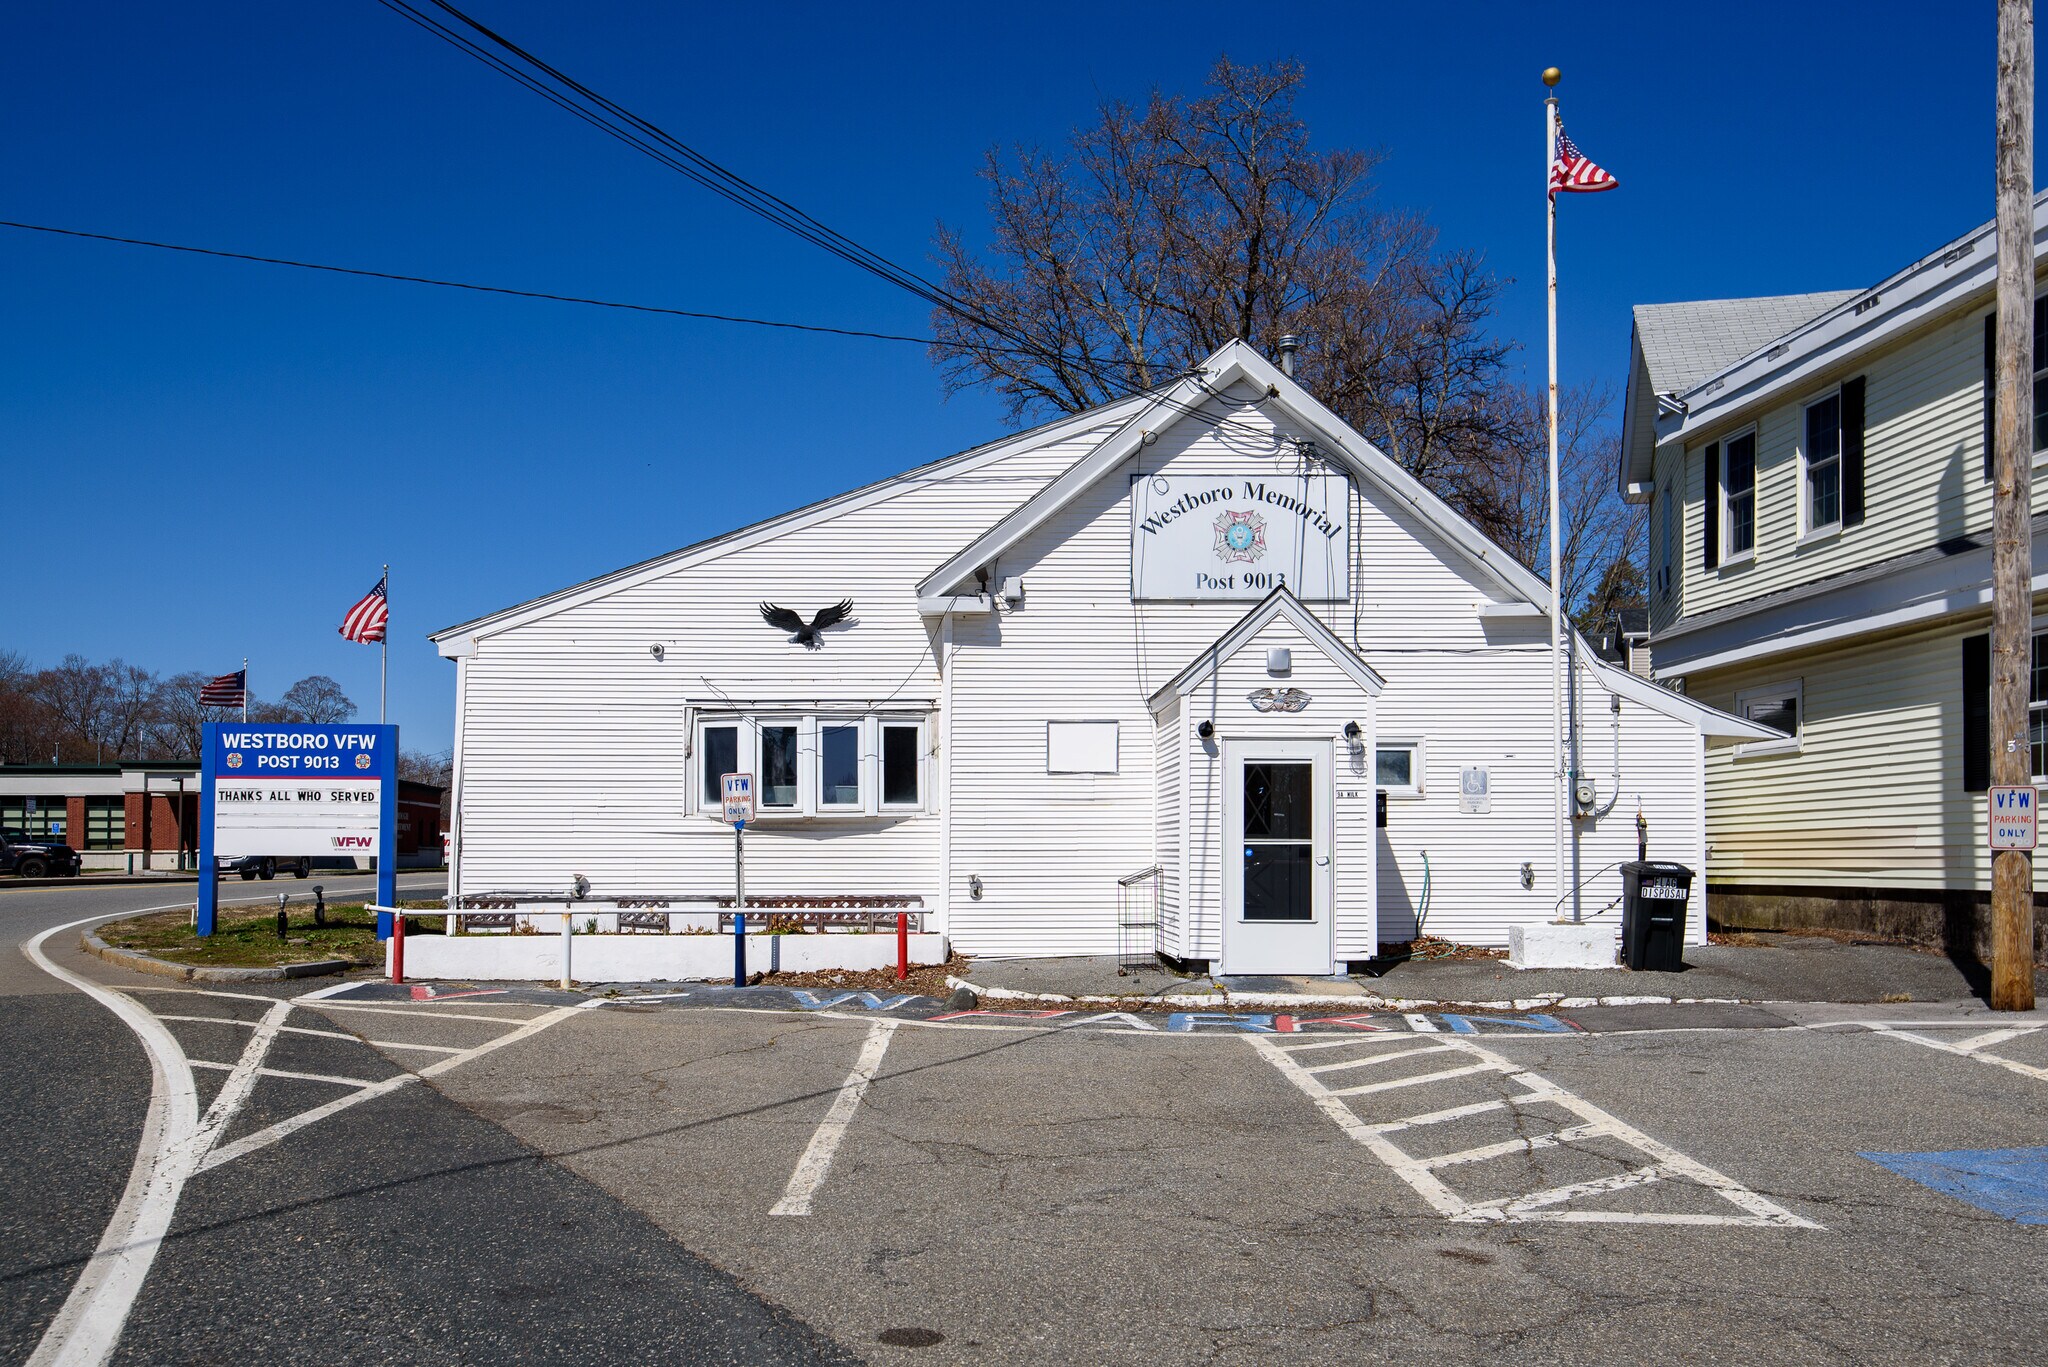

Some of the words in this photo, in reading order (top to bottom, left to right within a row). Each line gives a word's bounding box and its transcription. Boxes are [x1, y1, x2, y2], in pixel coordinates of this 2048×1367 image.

[1140, 487, 1233, 536] Westboro
[1243, 481, 1342, 540] Memorial
[1196, 573, 1235, 590] Post
[1243, 573, 1286, 590] 9013
[222, 733, 329, 750] WESTBORO
[334, 734, 376, 750] VFW
[258, 755, 300, 768] POST
[304, 755, 340, 769] 9013
[727, 778, 749, 792] VFW
[219, 790, 263, 801] THANKS
[269, 790, 291, 801] ALL
[297, 790, 321, 801] WHO
[331, 791, 375, 802] SERVED
[725, 795, 751, 803] PARKING
[1996, 792, 2030, 809] VFW
[728, 807, 746, 815] ONLY
[1994, 815, 2032, 824] PARKING
[1999, 828, 2027, 838] ONLY
[336, 836, 373, 847] VFW
[1654, 877, 1677, 888] FLAG
[1642, 888, 1686, 899] DISPOSAL
